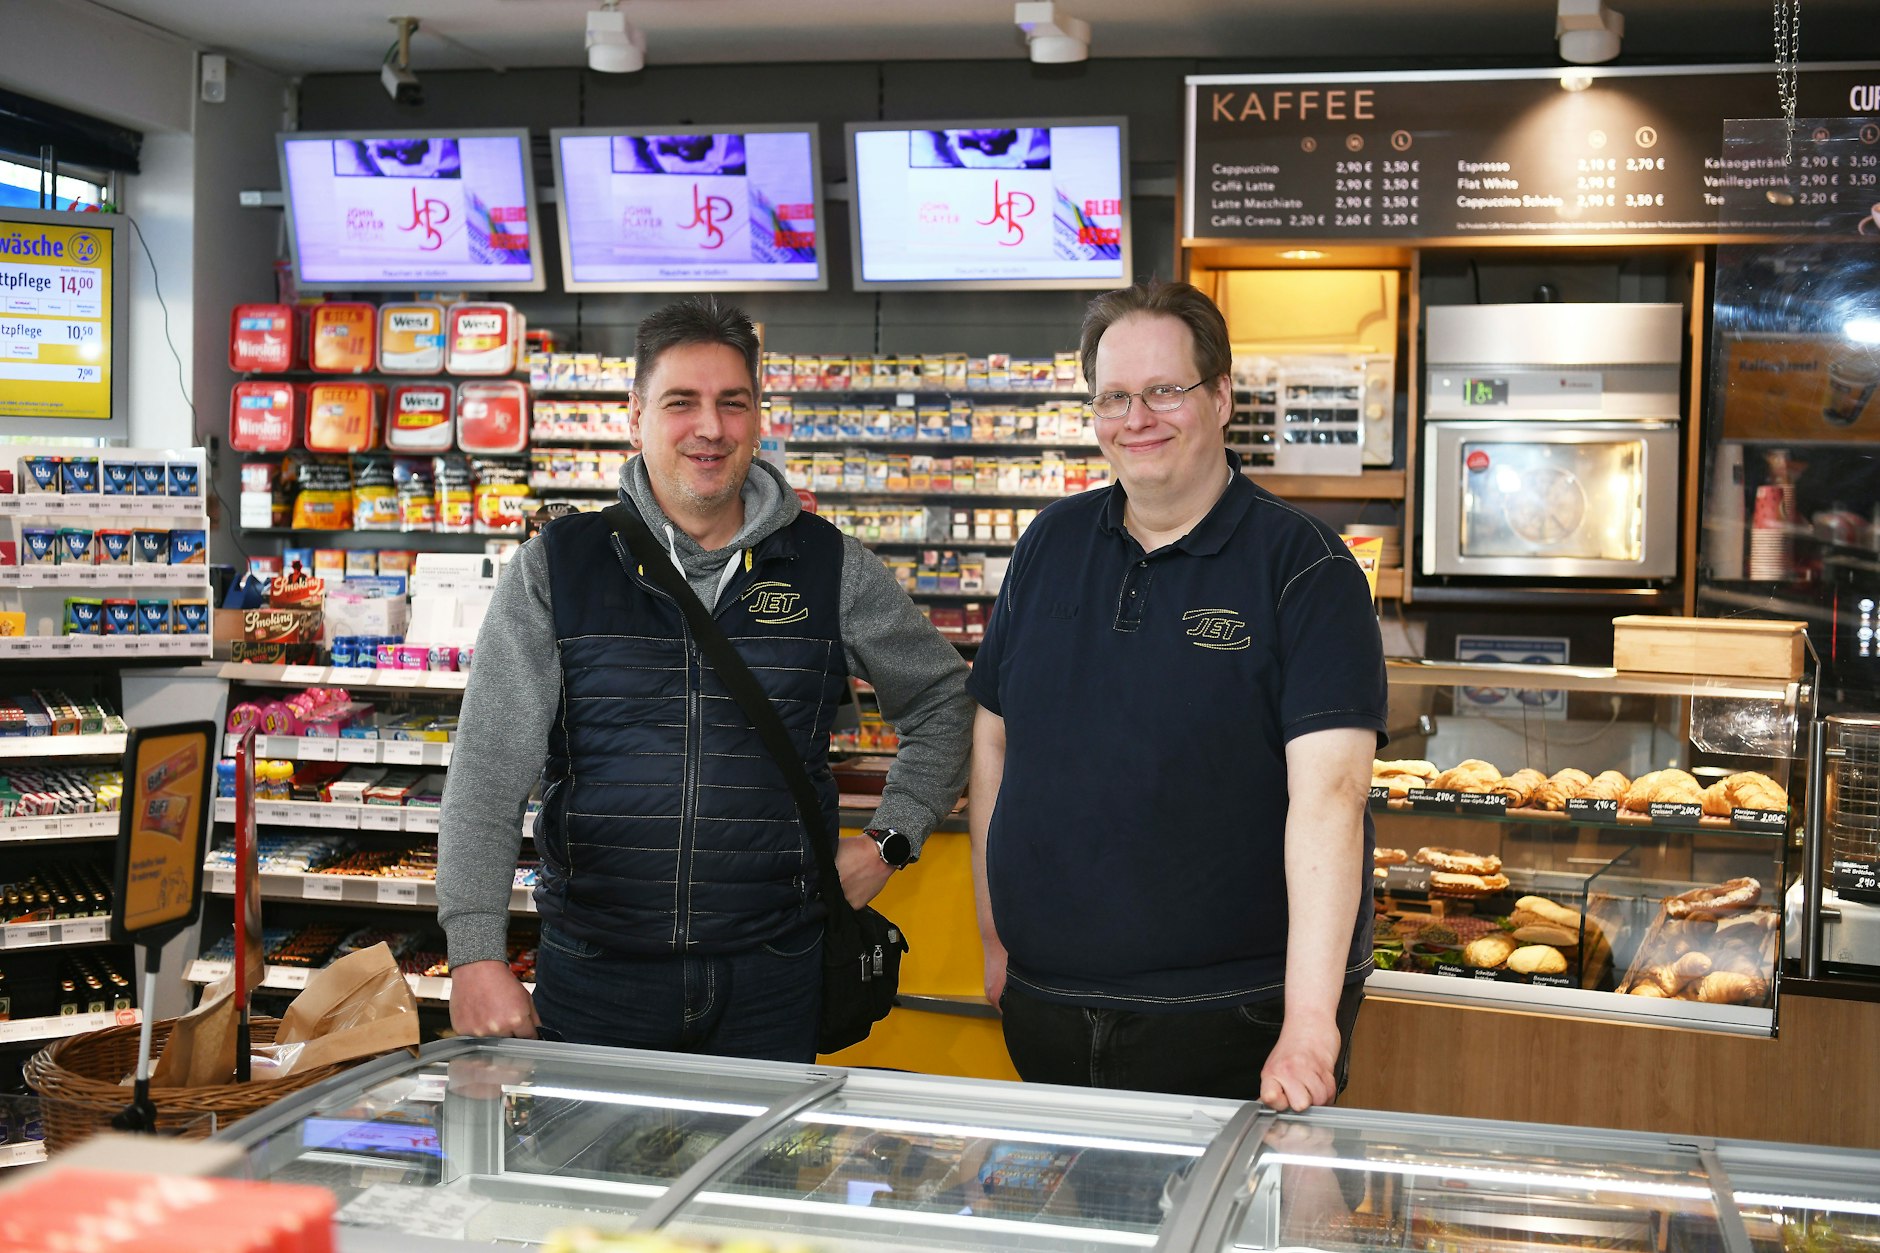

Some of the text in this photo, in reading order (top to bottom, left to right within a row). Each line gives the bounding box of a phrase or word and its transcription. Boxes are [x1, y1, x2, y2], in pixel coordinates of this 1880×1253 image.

[1212, 90, 1375, 122] KAFFEE
[1212, 160, 1420, 176] Cappuccino 2,90 € 3,50 €
[1458, 160, 1511, 173] Espresso
[1626, 158, 1654, 172] 2,70
[1656, 158, 1665, 171] €
[1704, 155, 1877, 171] Kakaogetränk 2,90 € 3,50
[1245, 181, 1275, 192] Latte
[1335, 179, 1362, 192] 2,90
[1364, 179, 1372, 191] €
[1382, 178, 1409, 192] 3,50
[1411, 179, 1420, 191] €
[1457, 178, 1481, 190] Flat
[1483, 177, 1519, 190] White
[1703, 174, 1877, 189] Vanillegetränk 2,90 € 3,50
[1211, 196, 1419, 210] Latte Macchiato 2,90 € 3,50 €
[1457, 195, 1522, 209] Cappuccino
[1655, 194, 1664, 207] €
[1703, 193, 1839, 206] Tee 2,20 €
[1245, 215, 1282, 227] Crema
[1289, 214, 1316, 227] 2,20
[1317, 214, 1326, 226] €
[1335, 214, 1362, 227] 2,60
[1364, 214, 1372, 226] €
[1382, 214, 1408, 227] 3,20
[1411, 214, 1418, 226] €
[77, 242, 94, 255] 2.6
[59, 275, 93, 296] 14,00
[393, 316, 428, 327] West
[462, 319, 496, 329] West
[66, 325, 93, 341] 10,50
[238, 339, 281, 357] Winston
[405, 396, 439, 407] West
[238, 416, 281, 435] Winston
[36, 467, 50, 478] blu
[74, 467, 88, 478] blu
[112, 470, 126, 480] blu
[145, 471, 158, 480] blu
[177, 471, 190, 481] blu
[33, 540, 46, 549] blu
[70, 539, 84, 549] blu
[109, 540, 122, 549] blu
[144, 539, 158, 549] blu
[178, 541, 192, 552] blu
[272, 576, 321, 597] Smoking
[748, 591, 801, 613] JET
[79, 610, 92, 619] blu
[115, 610, 128, 619] blu
[147, 610, 161, 619] blu
[186, 610, 200, 619] blu
[245, 612, 293, 633] Smoking
[1186, 617, 1245, 640] JET
[231, 643, 281, 662] Smoking
[147, 764, 168, 791] BiFi
[148, 800, 169, 816] BiFi
